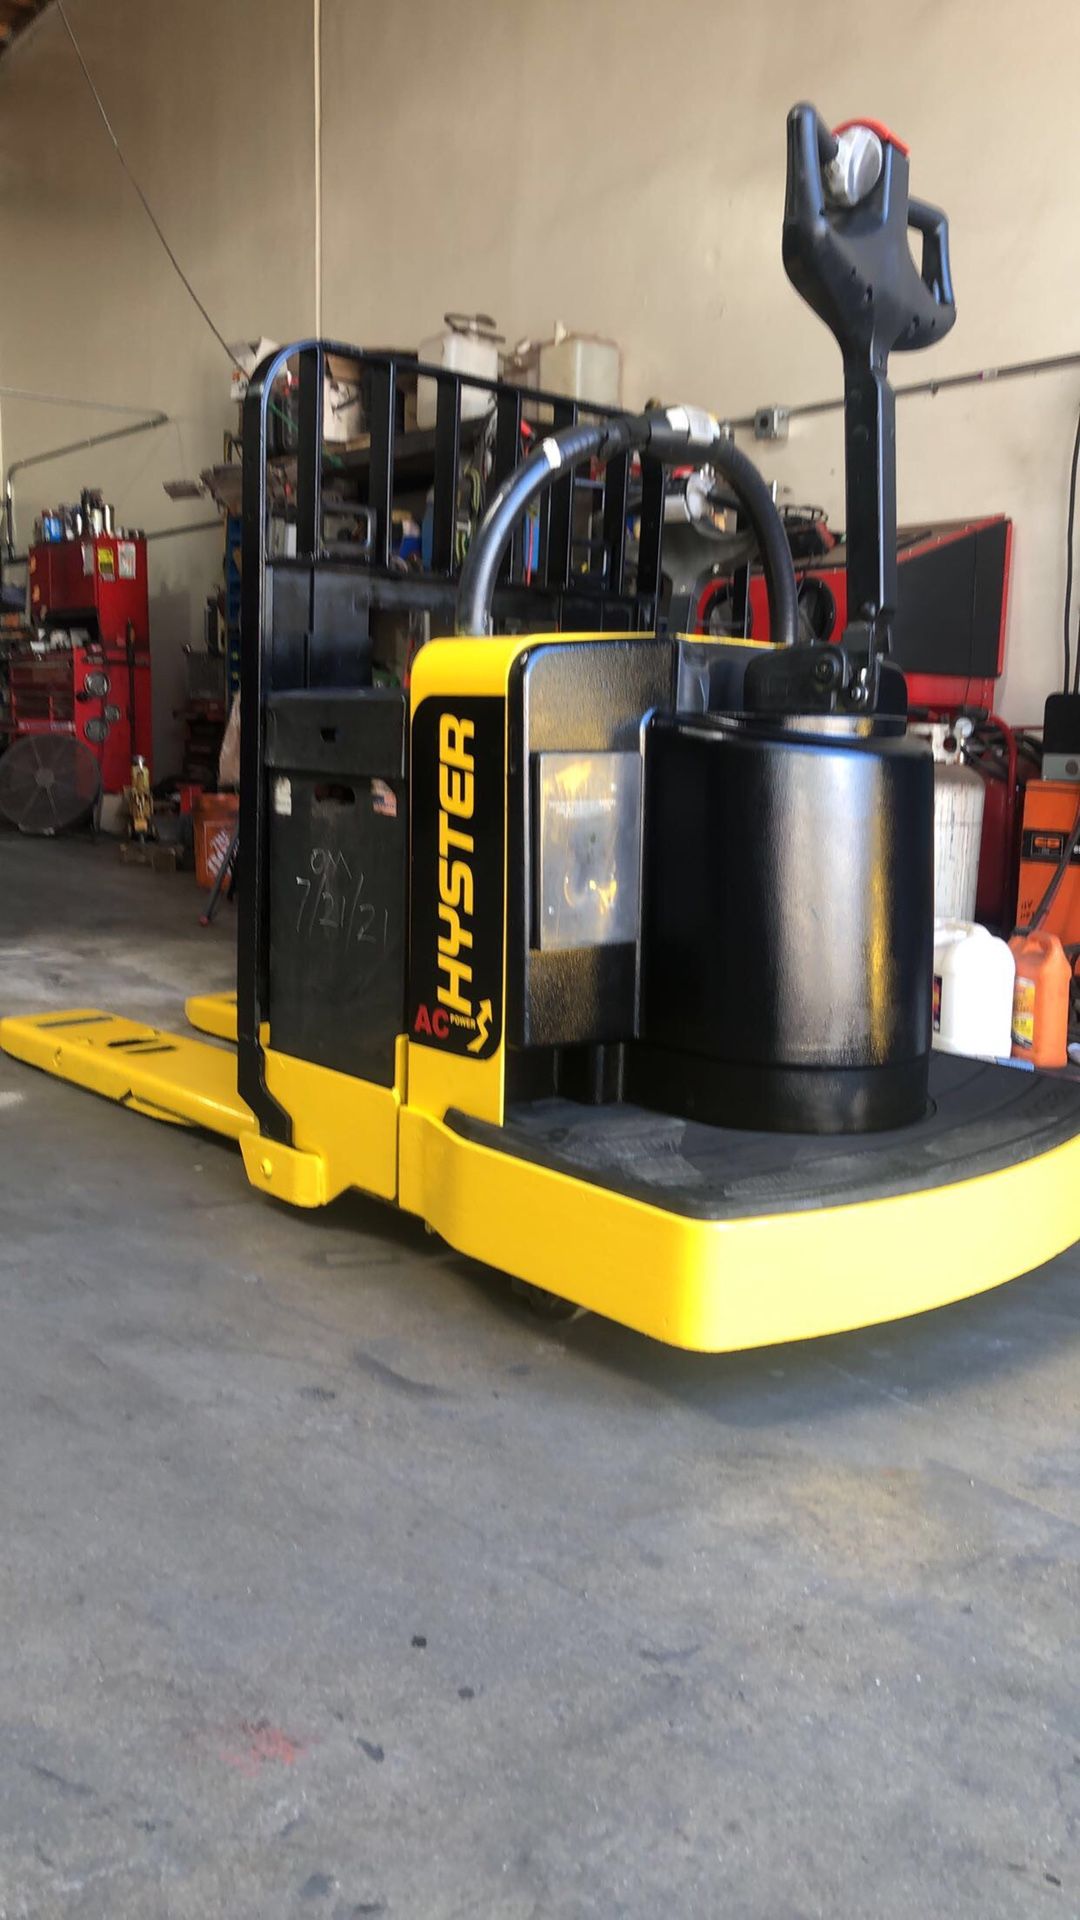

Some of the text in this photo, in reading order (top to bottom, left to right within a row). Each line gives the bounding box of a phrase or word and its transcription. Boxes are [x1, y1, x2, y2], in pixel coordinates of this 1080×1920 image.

[437, 712, 475, 1017] HYSTER
[414, 1003, 476, 1039] AC POWER
